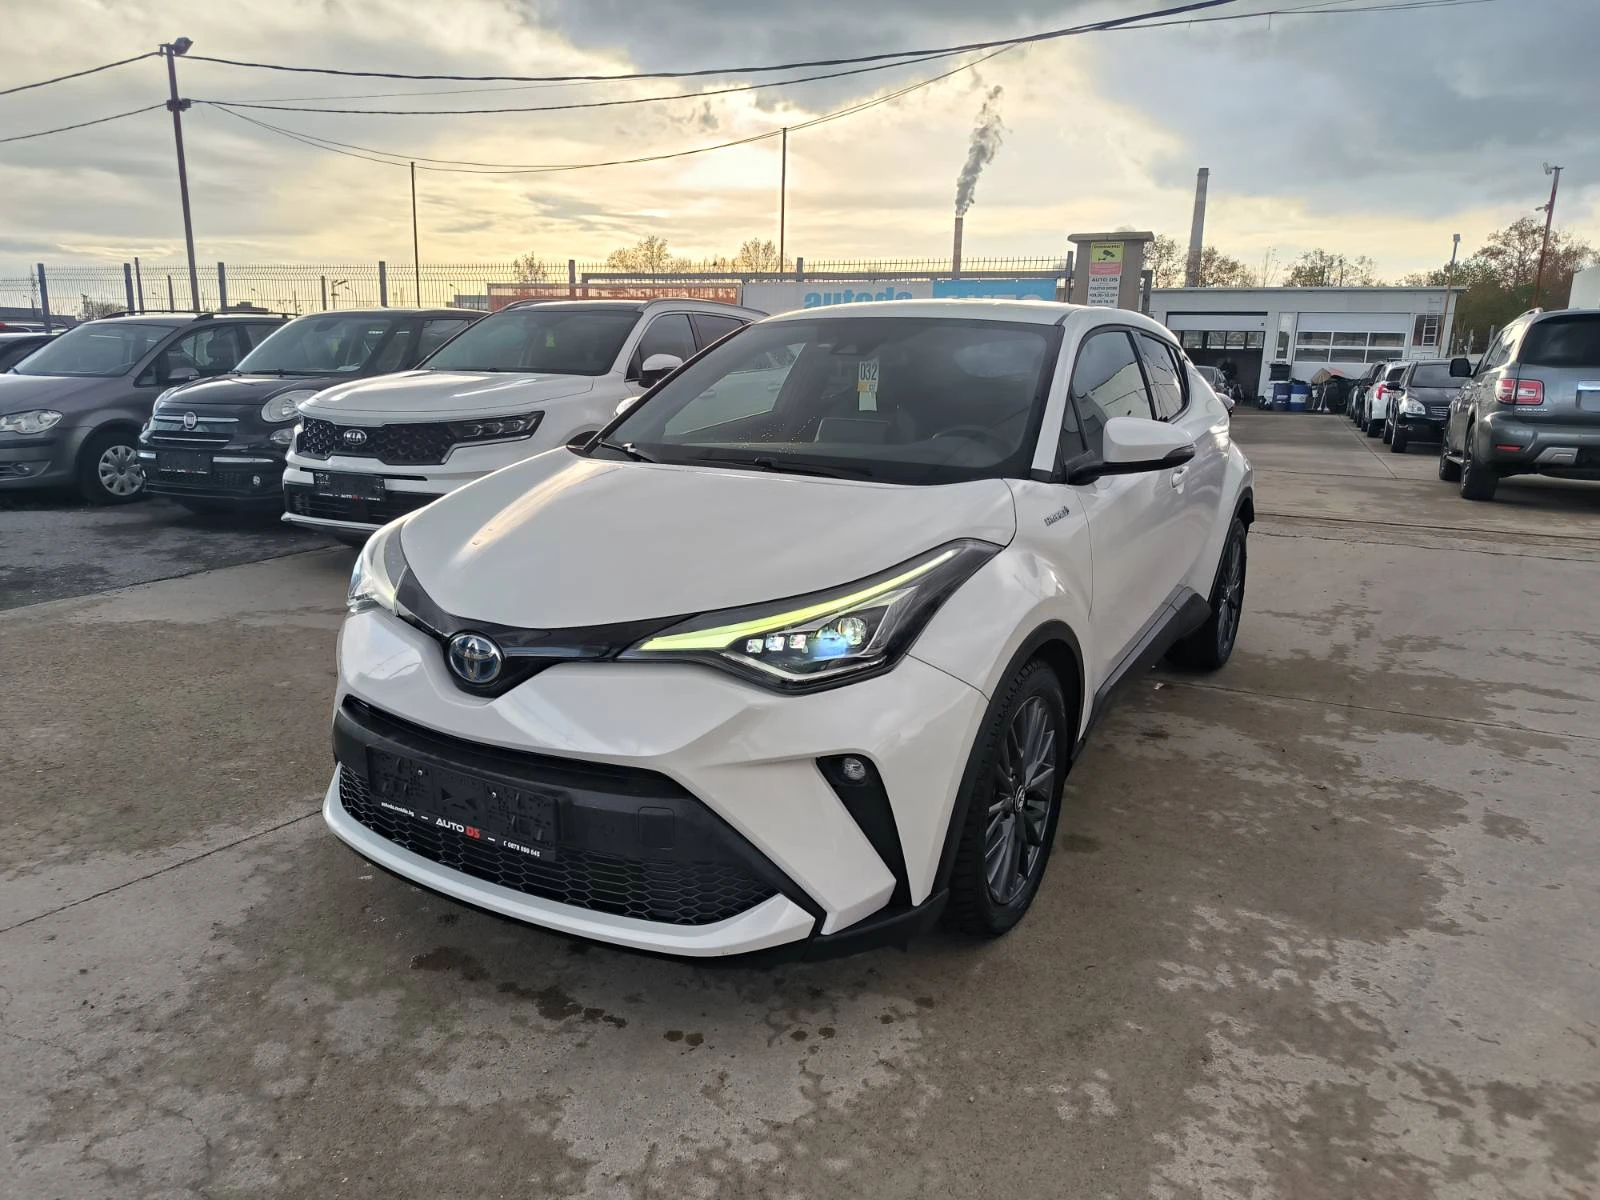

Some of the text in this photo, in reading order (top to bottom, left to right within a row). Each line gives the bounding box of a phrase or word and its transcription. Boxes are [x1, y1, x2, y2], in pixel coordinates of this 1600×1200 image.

[860, 362, 878, 381] 032
[346, 432, 362, 442] KIA
[435, 817, 465, 833] AUTO
